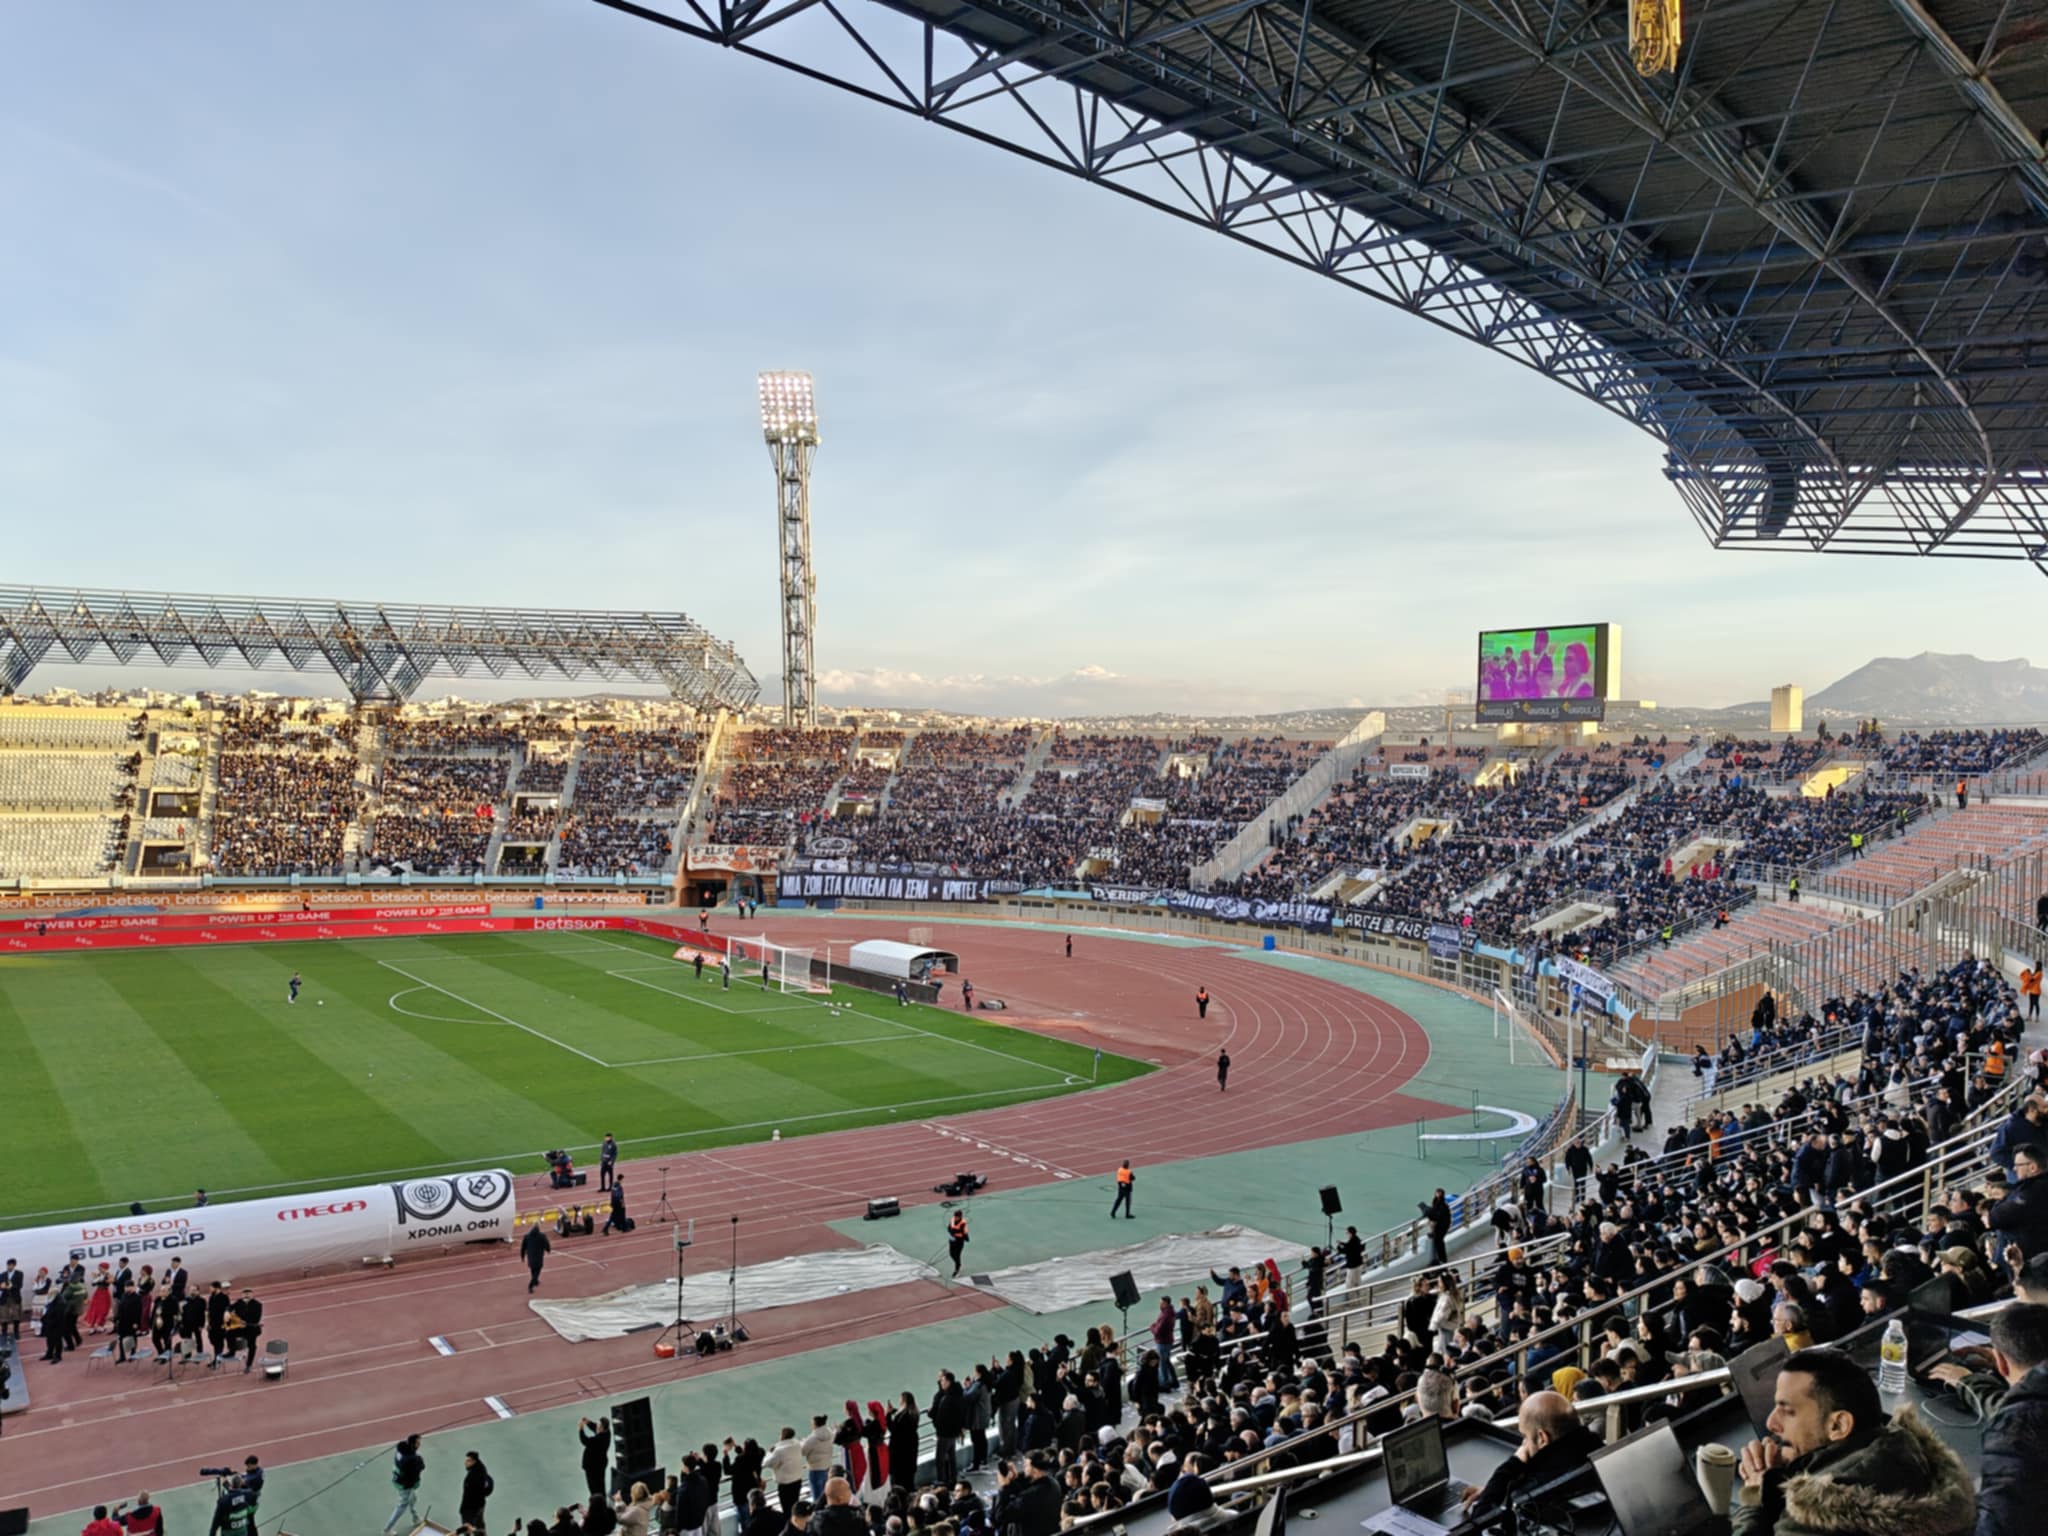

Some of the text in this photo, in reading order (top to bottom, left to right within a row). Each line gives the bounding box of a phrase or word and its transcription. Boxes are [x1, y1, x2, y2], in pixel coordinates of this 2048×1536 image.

[34, 896, 101, 909] betsson
[106, 894, 170, 906] betsson
[175, 893, 237, 905] betsson
[246, 892, 300, 904] betsson
[311, 892, 364, 903] betsson
[372, 891, 424, 903] betsson
[430, 891, 481, 903] betsson
[485, 892, 534, 903] betsson
[209, 914, 255, 924] POWER
[258, 914, 275, 923] UP
[296, 911, 330, 921] GAME
[375, 908, 418, 918] POWER
[420, 908, 436, 917] UP
[454, 906, 487, 915] GAME
[24, 919, 75, 930] POWER
[77, 919, 97, 929] UP
[120, 917, 158, 927] GAME
[533, 917, 606, 930] betsson
[277, 1200, 367, 1221] MEGA
[81, 1218, 190, 1241] betsson
[408, 1217, 500, 1240] ΧΡΟΝΙΑ ΟΦΗ
